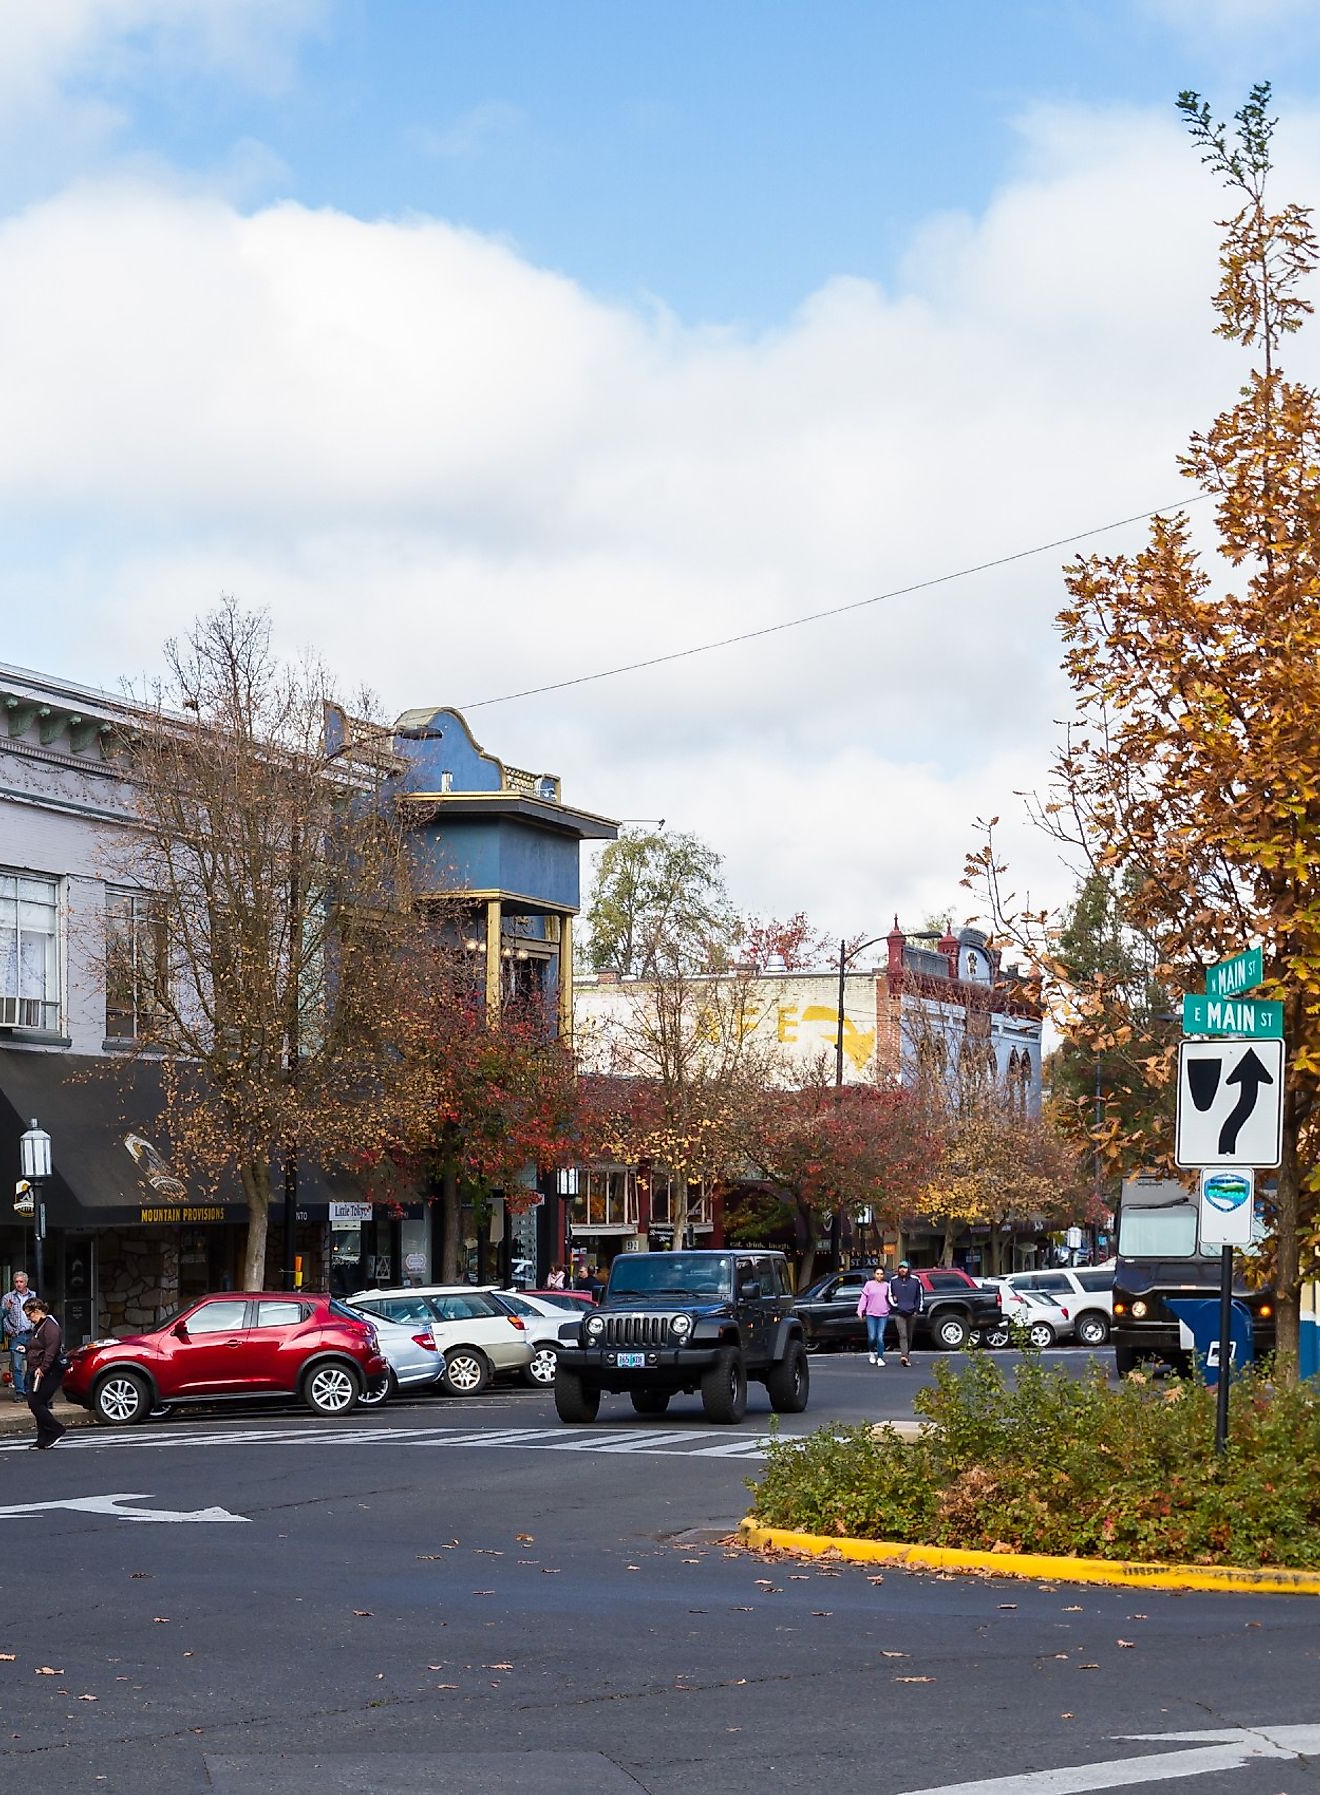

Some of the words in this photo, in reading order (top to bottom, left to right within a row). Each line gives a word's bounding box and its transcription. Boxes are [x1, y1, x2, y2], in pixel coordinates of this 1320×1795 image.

[1218, 959, 1246, 996] MAIN
[1248, 961, 1256, 976] ST
[1195, 1007, 1201, 1022] E
[1207, 1001, 1255, 1032] MAIN
[1260, 1013, 1272, 1027] ST
[141, 1208, 180, 1222] MOUNTAIN
[183, 1207, 224, 1221] PROVISIONS
[335, 1205, 350, 1217] Little
[351, 1205, 370, 1219] Tokyo
